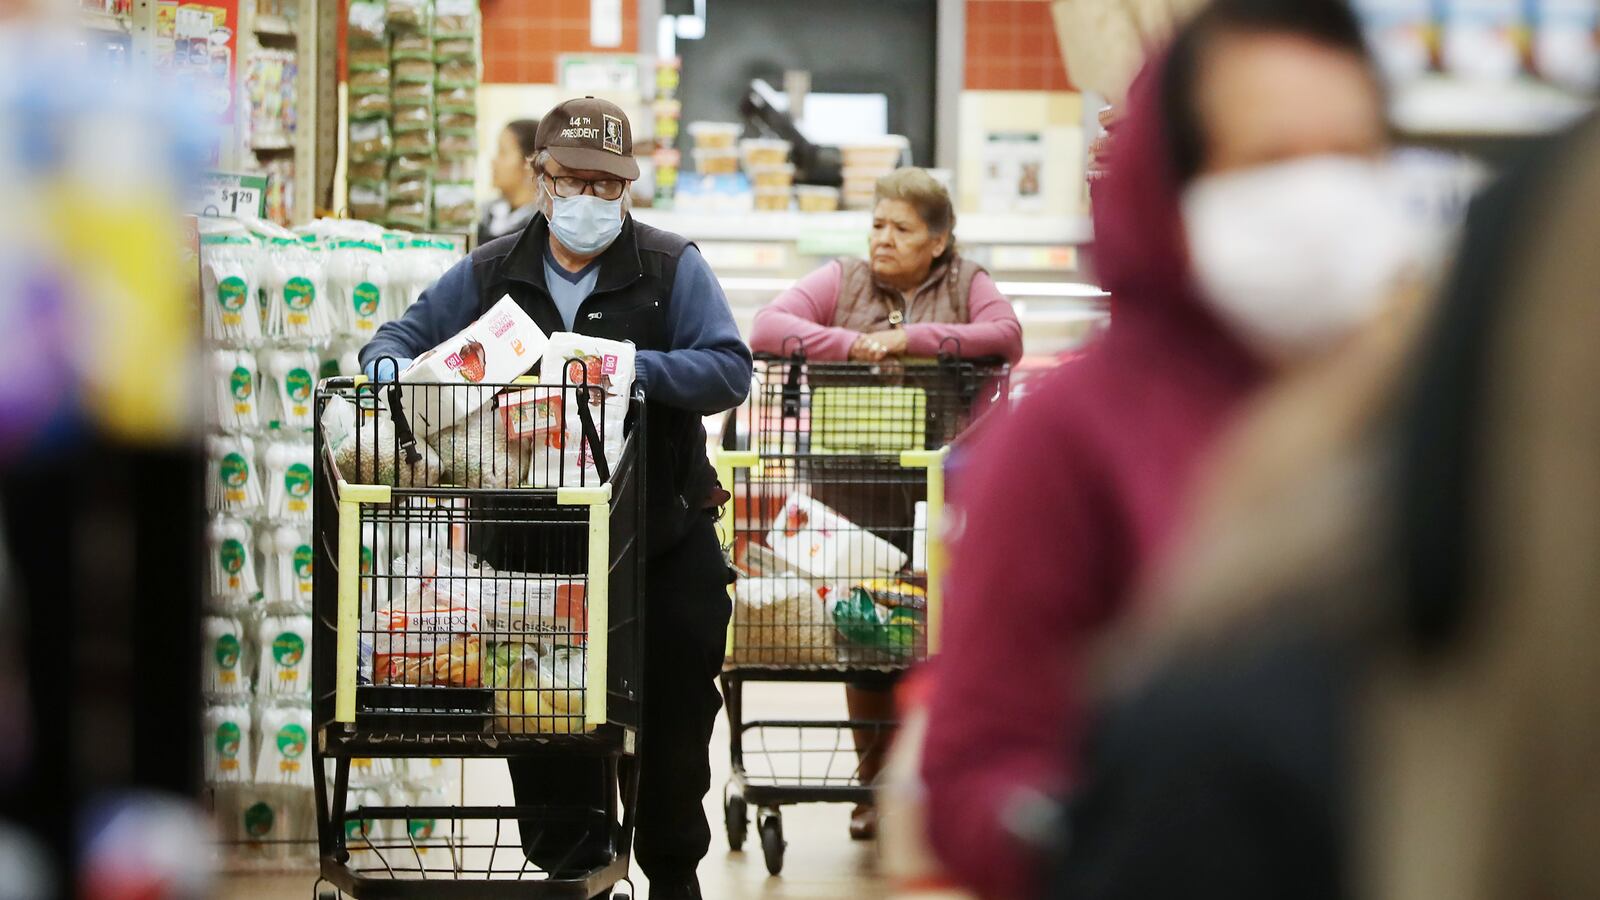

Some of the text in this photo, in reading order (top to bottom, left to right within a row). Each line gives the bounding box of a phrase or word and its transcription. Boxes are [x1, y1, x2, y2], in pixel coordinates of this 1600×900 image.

[569, 117, 581, 127] 44
[560, 128, 599, 139] PRESIDENT
[446, 355, 461, 369] 180
[605, 355, 615, 372] 180
[412, 616, 419, 626] 8
[420, 616, 442, 626] HOT
[512, 619, 567, 632] Chicken
